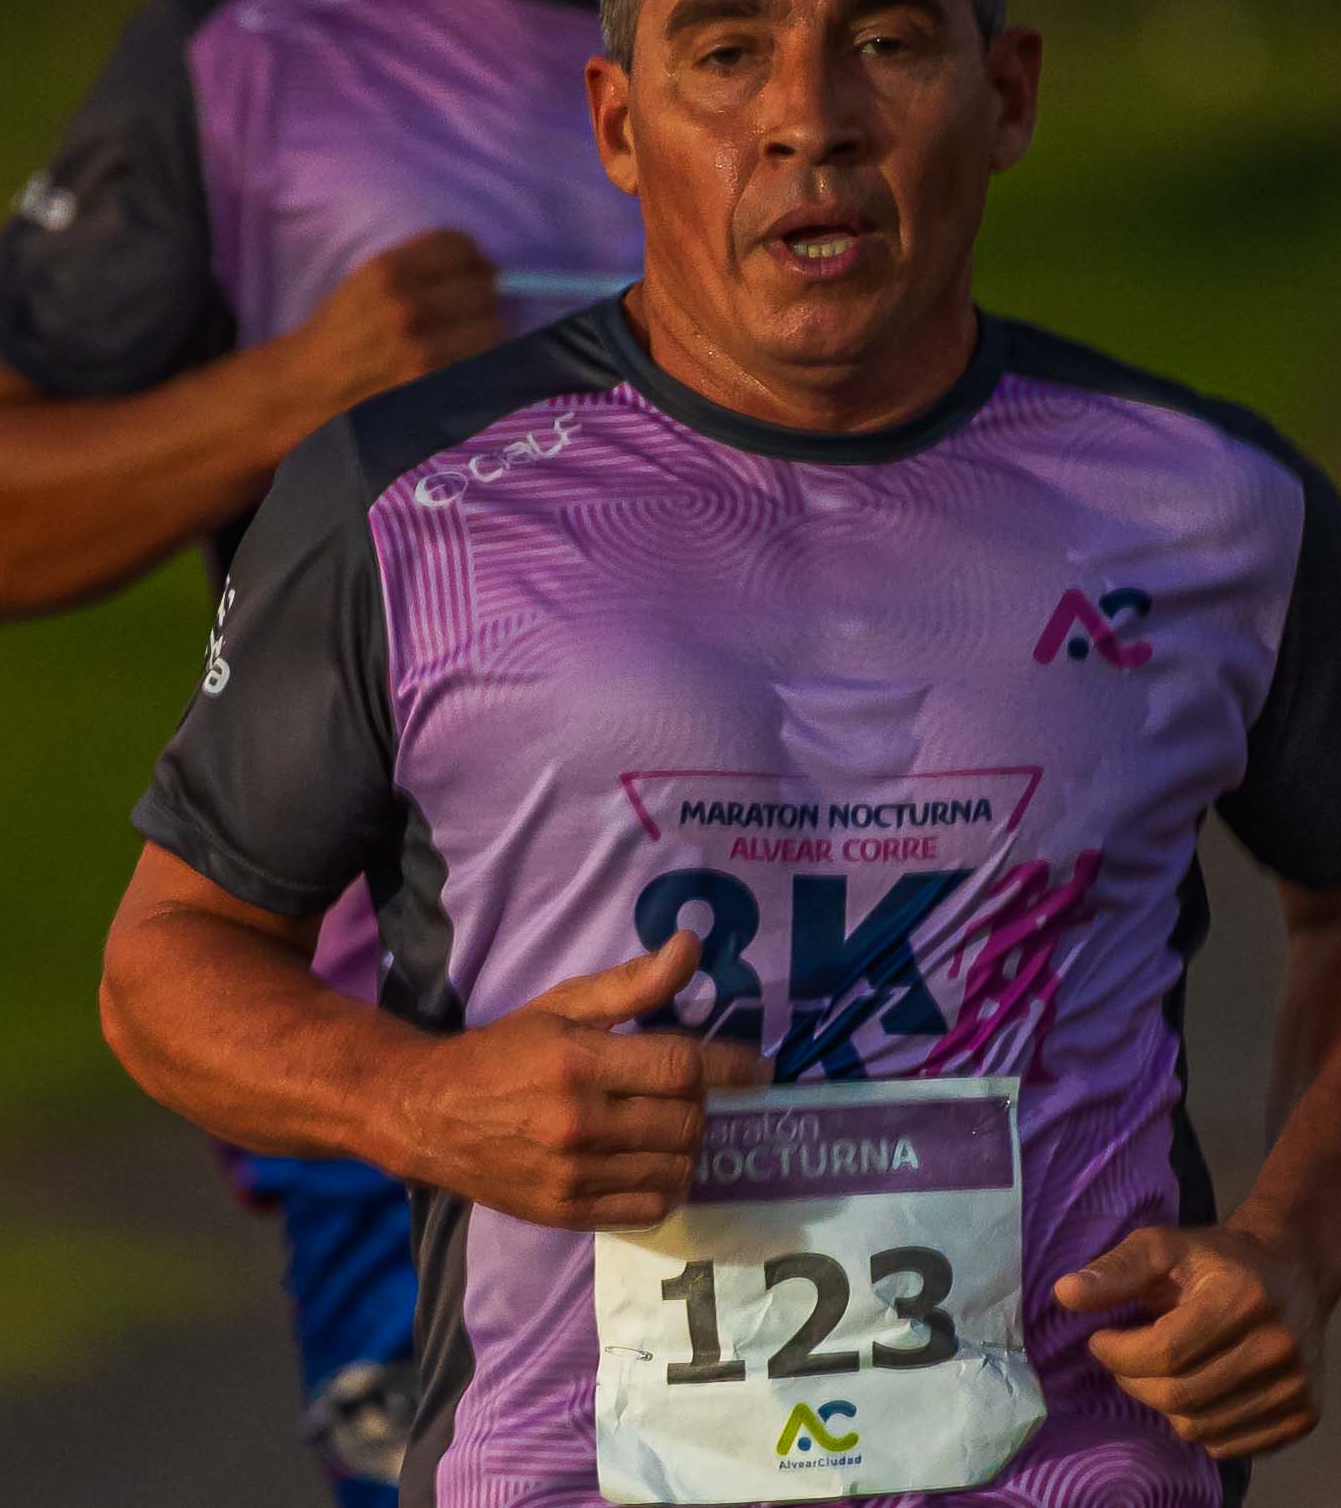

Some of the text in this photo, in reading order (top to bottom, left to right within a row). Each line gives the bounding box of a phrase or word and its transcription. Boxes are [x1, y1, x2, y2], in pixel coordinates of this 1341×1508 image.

[679, 798, 993, 829] MARATON NOCTURNA
[729, 836, 940, 863] ALVEAR CORRE
[661, 1245, 959, 1385] 123
